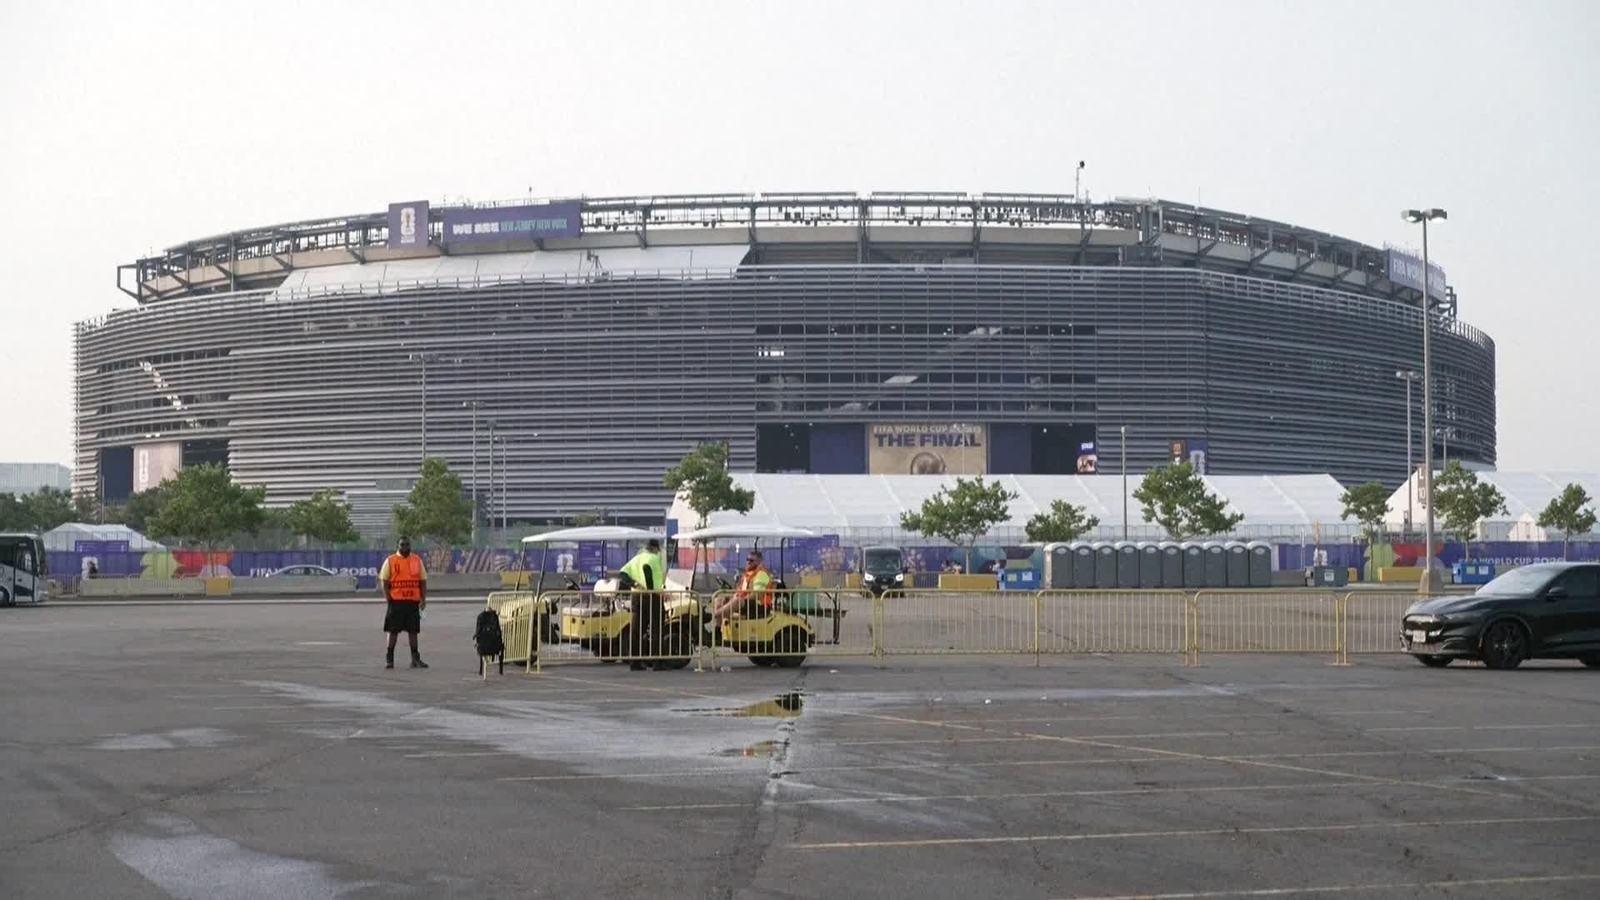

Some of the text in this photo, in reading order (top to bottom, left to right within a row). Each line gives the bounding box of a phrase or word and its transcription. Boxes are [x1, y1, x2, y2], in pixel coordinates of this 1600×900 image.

[873, 425, 894, 434] FIFA
[896, 425, 929, 434] WORLD
[929, 425, 947, 434] CUP
[874, 433, 982, 447] THE FINAL
[1513, 556, 1532, 566] CUP
